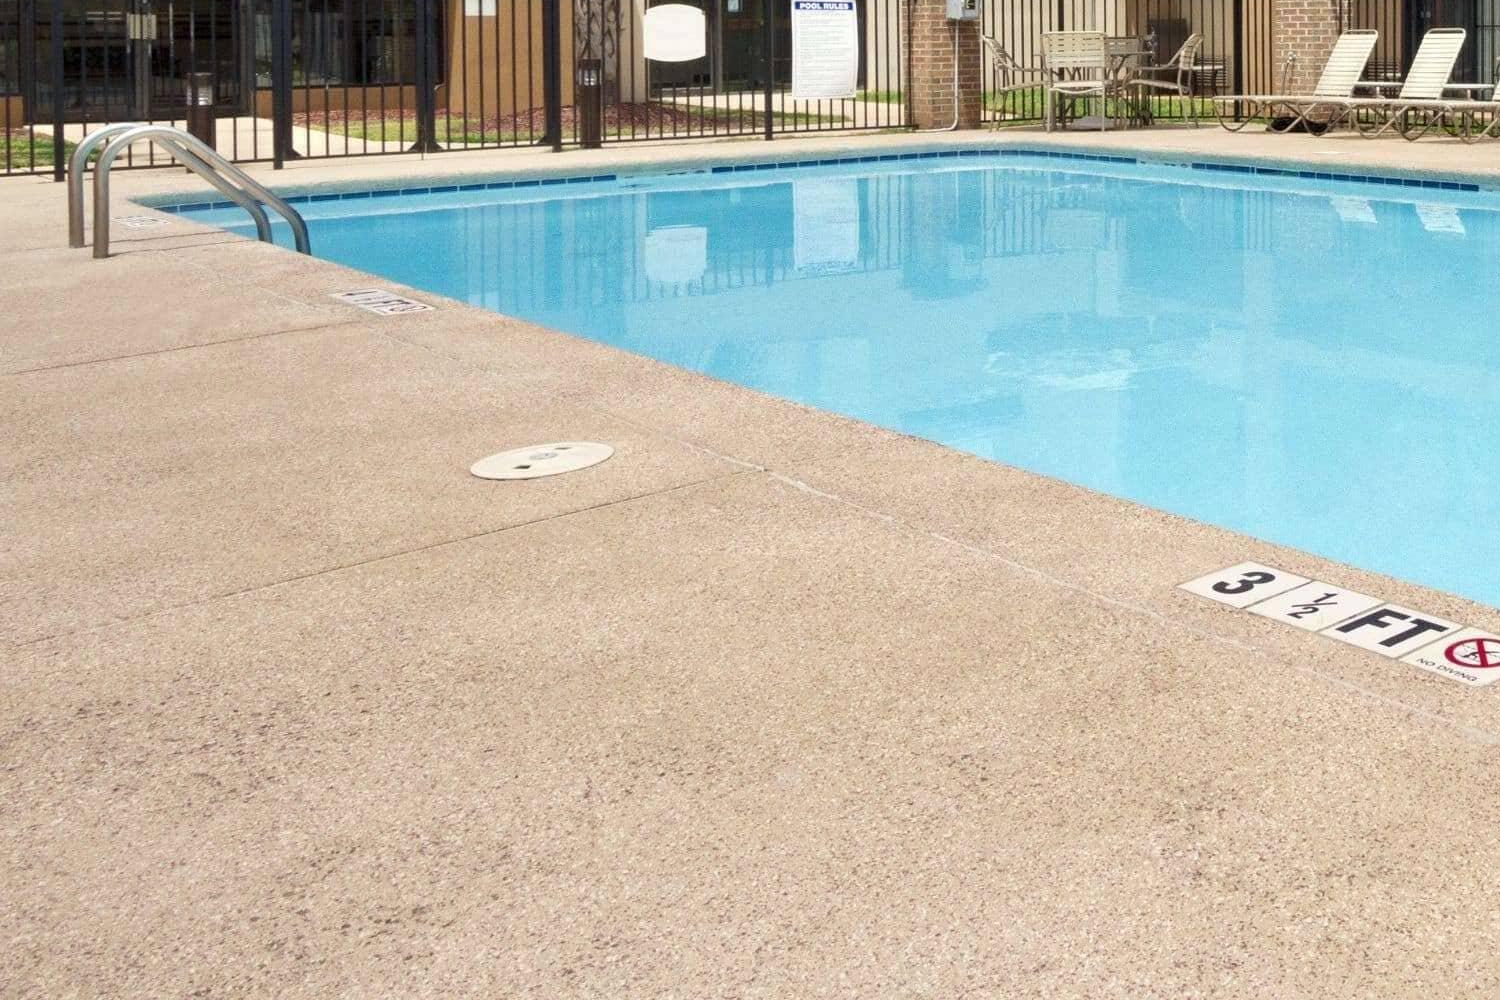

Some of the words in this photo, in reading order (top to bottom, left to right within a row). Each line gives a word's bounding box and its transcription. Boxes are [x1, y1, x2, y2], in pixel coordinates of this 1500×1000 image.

[799, 2, 823, 10] POOL
[823, 2, 849, 10] RULES
[1211, 571, 1276, 595] 3
[1335, 608, 1449, 648] FT
[1416, 657, 1435, 667] NO
[1437, 664, 1478, 682] DIVING
